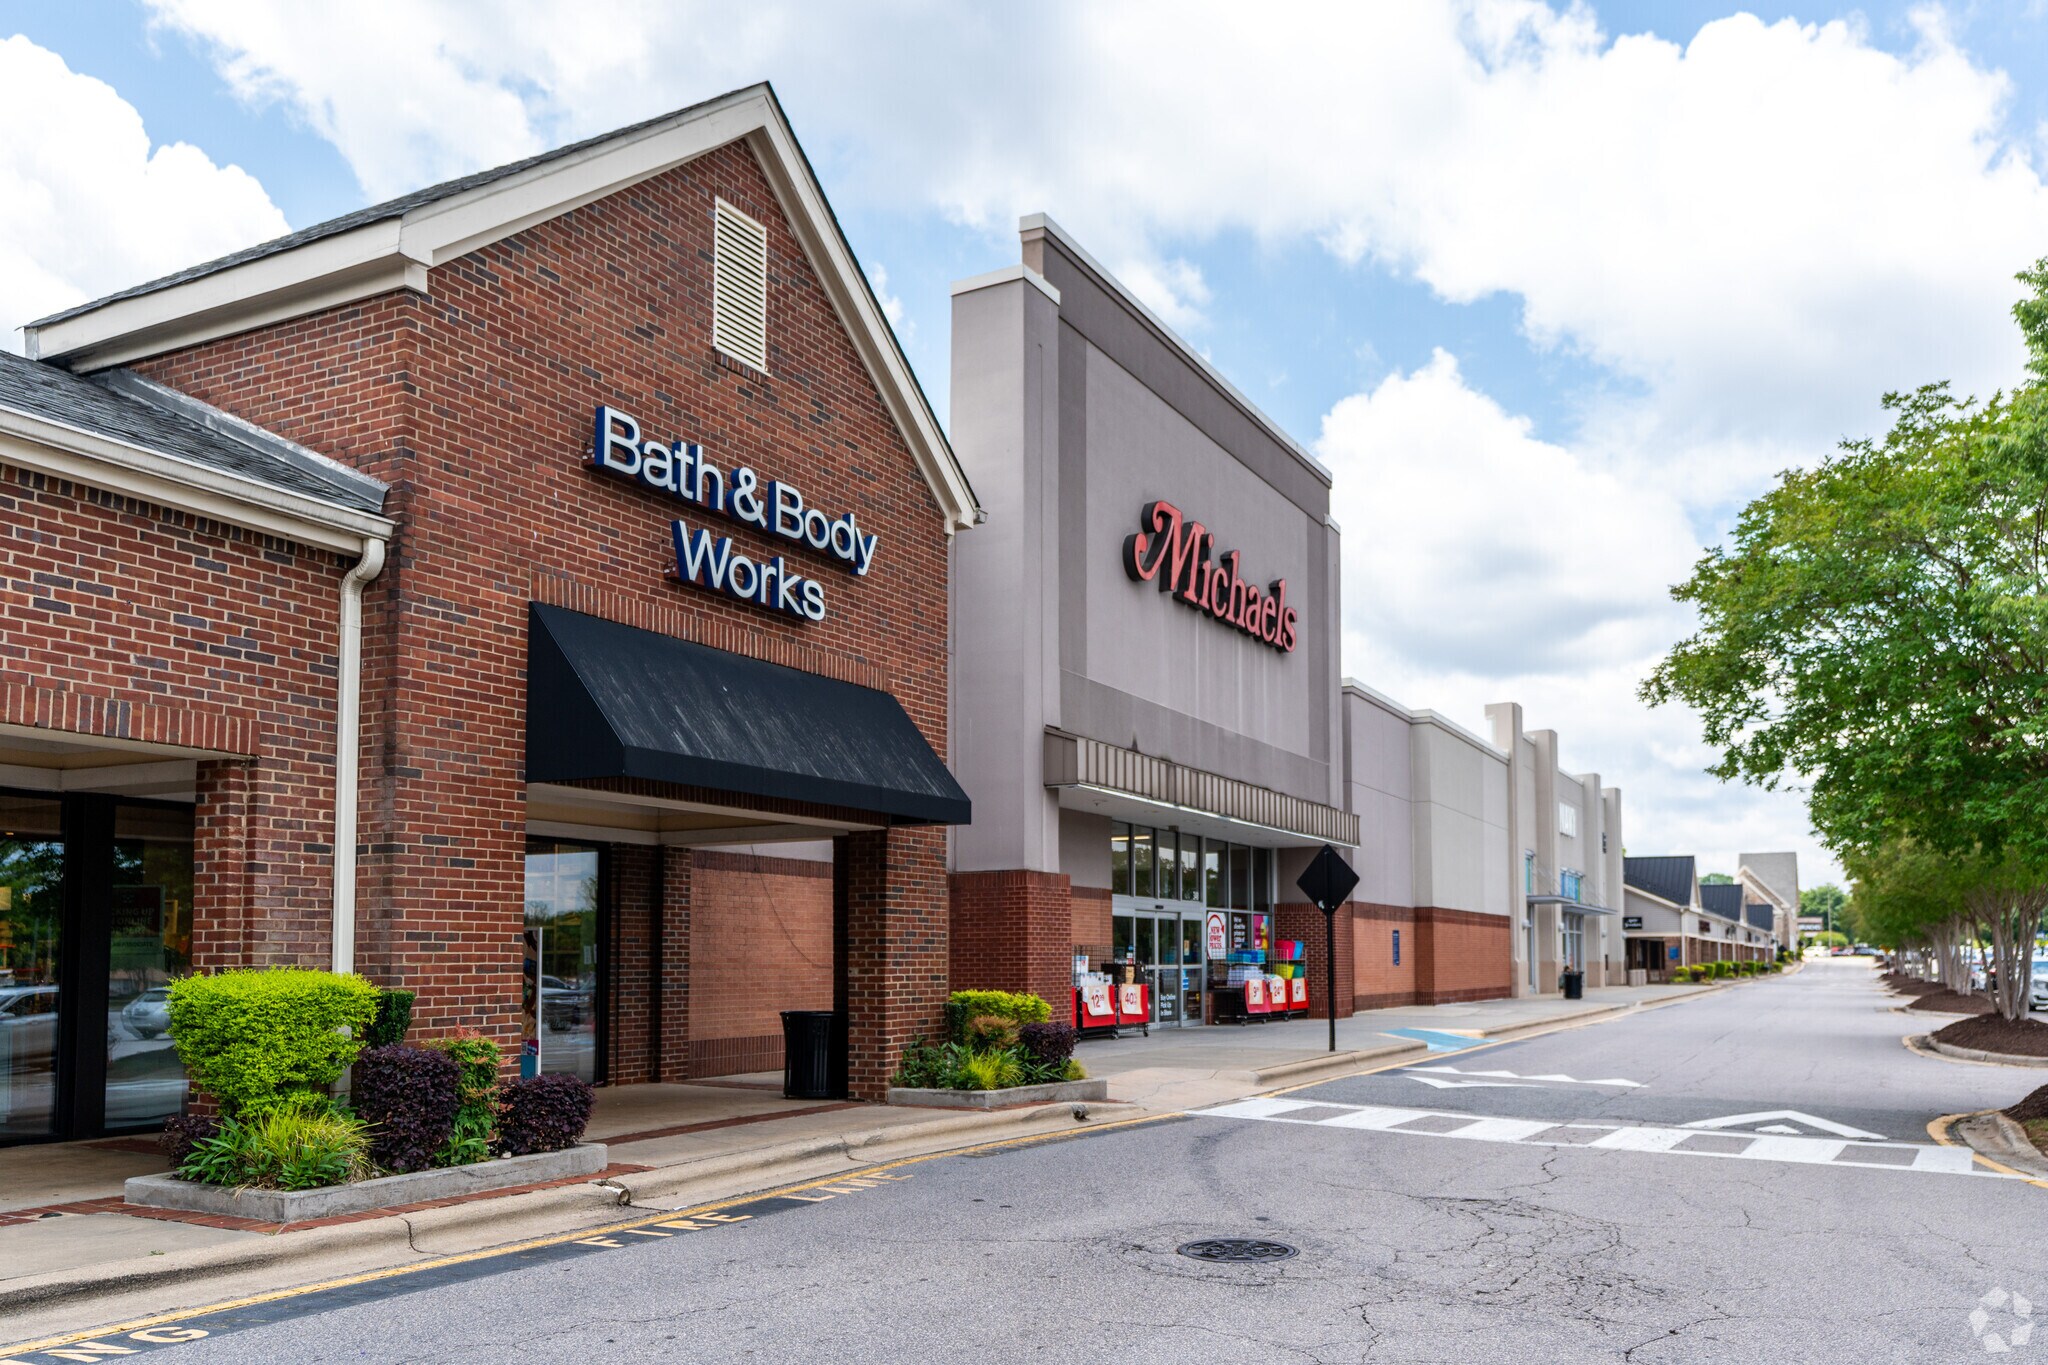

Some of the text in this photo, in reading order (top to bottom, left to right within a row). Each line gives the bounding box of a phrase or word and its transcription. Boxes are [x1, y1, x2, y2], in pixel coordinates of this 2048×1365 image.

[596, 405, 878, 576] Bath & Body
[671, 520, 825, 621] Works
[1127, 500, 1297, 653] Michaels
[573, 1172, 914, 1248] FIRE LANE
